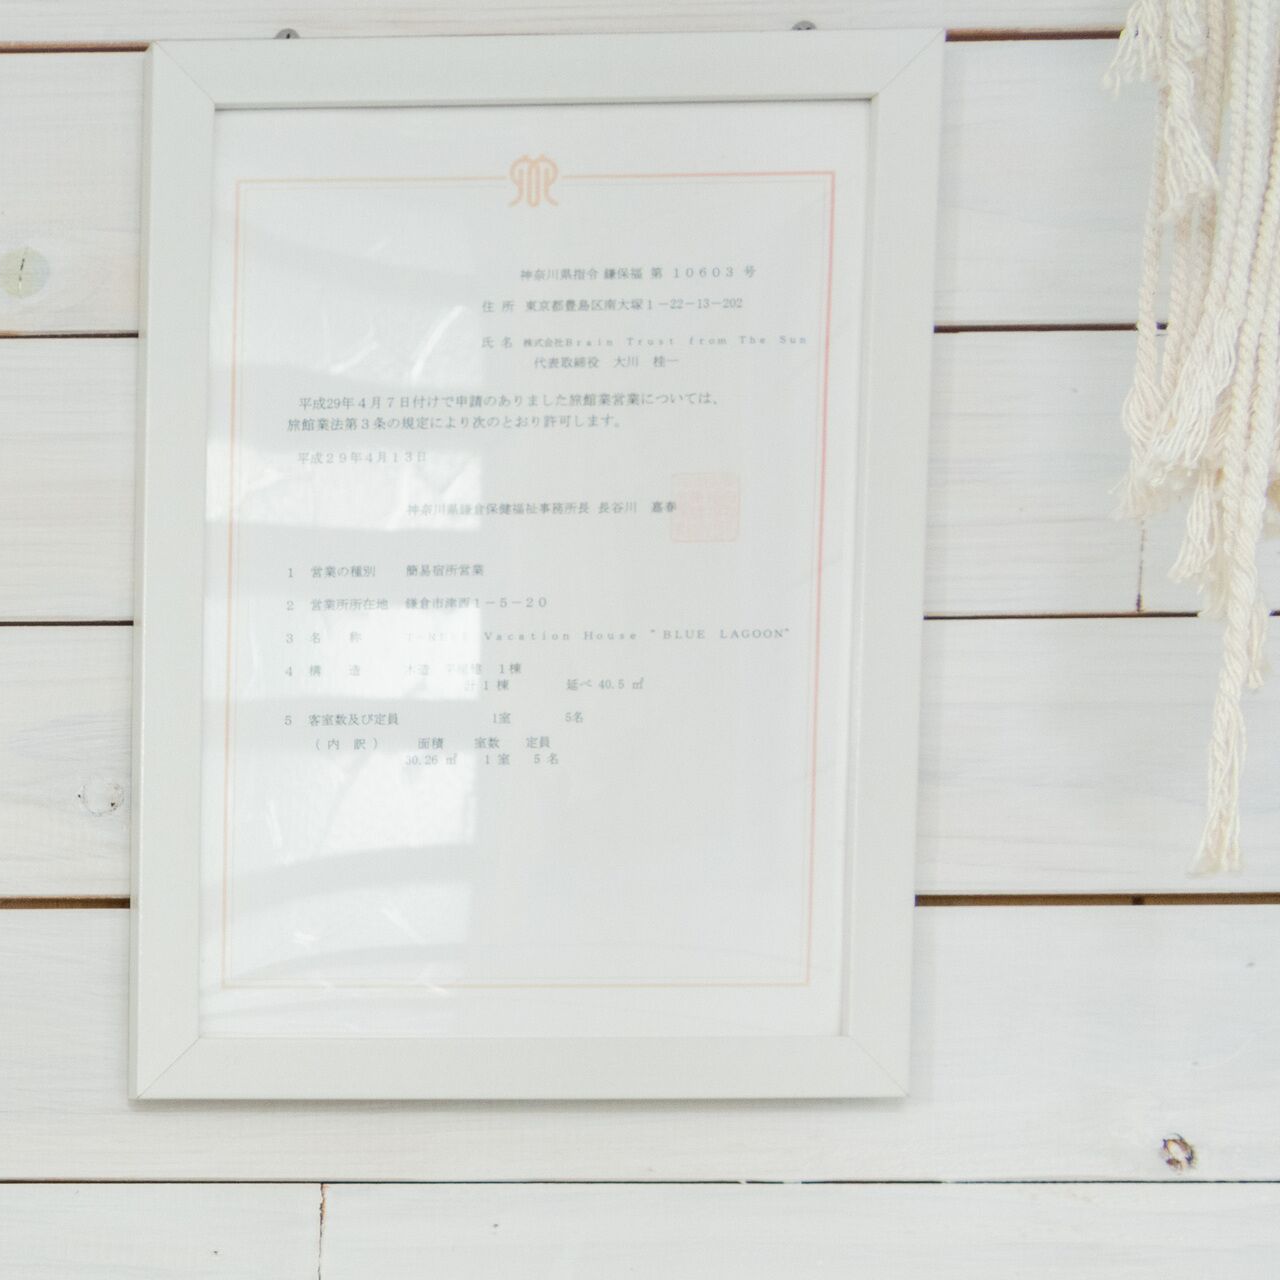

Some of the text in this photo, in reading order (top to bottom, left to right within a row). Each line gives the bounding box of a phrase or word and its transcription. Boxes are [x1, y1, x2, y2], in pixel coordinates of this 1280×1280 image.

[521, 268, 598, 281] 神奈川県指令
[650, 267, 663, 279] 第
[673, 267, 734, 278] 10603
[744, 266, 756, 278] 号
[779, 335, 806, 345] Sun
[534, 356, 599, 369] 代表取締役
[614, 355, 639, 368] 大川
[597, 501, 637, 515] 長谷川
[311, 566, 376, 578] 営業の種別
[286, 601, 294, 611] 2
[286, 633, 293, 643] 3
[484, 631, 570, 641] Vacation
[583, 630, 636, 640] House
[285, 666, 293, 677] 4
[285, 715, 292, 726] 5
[308, 713, 399, 727] 客室数及び定員
[418, 737, 444, 750] 面積
[474, 736, 500, 749] 室数
[526, 735, 551, 748] 定員
